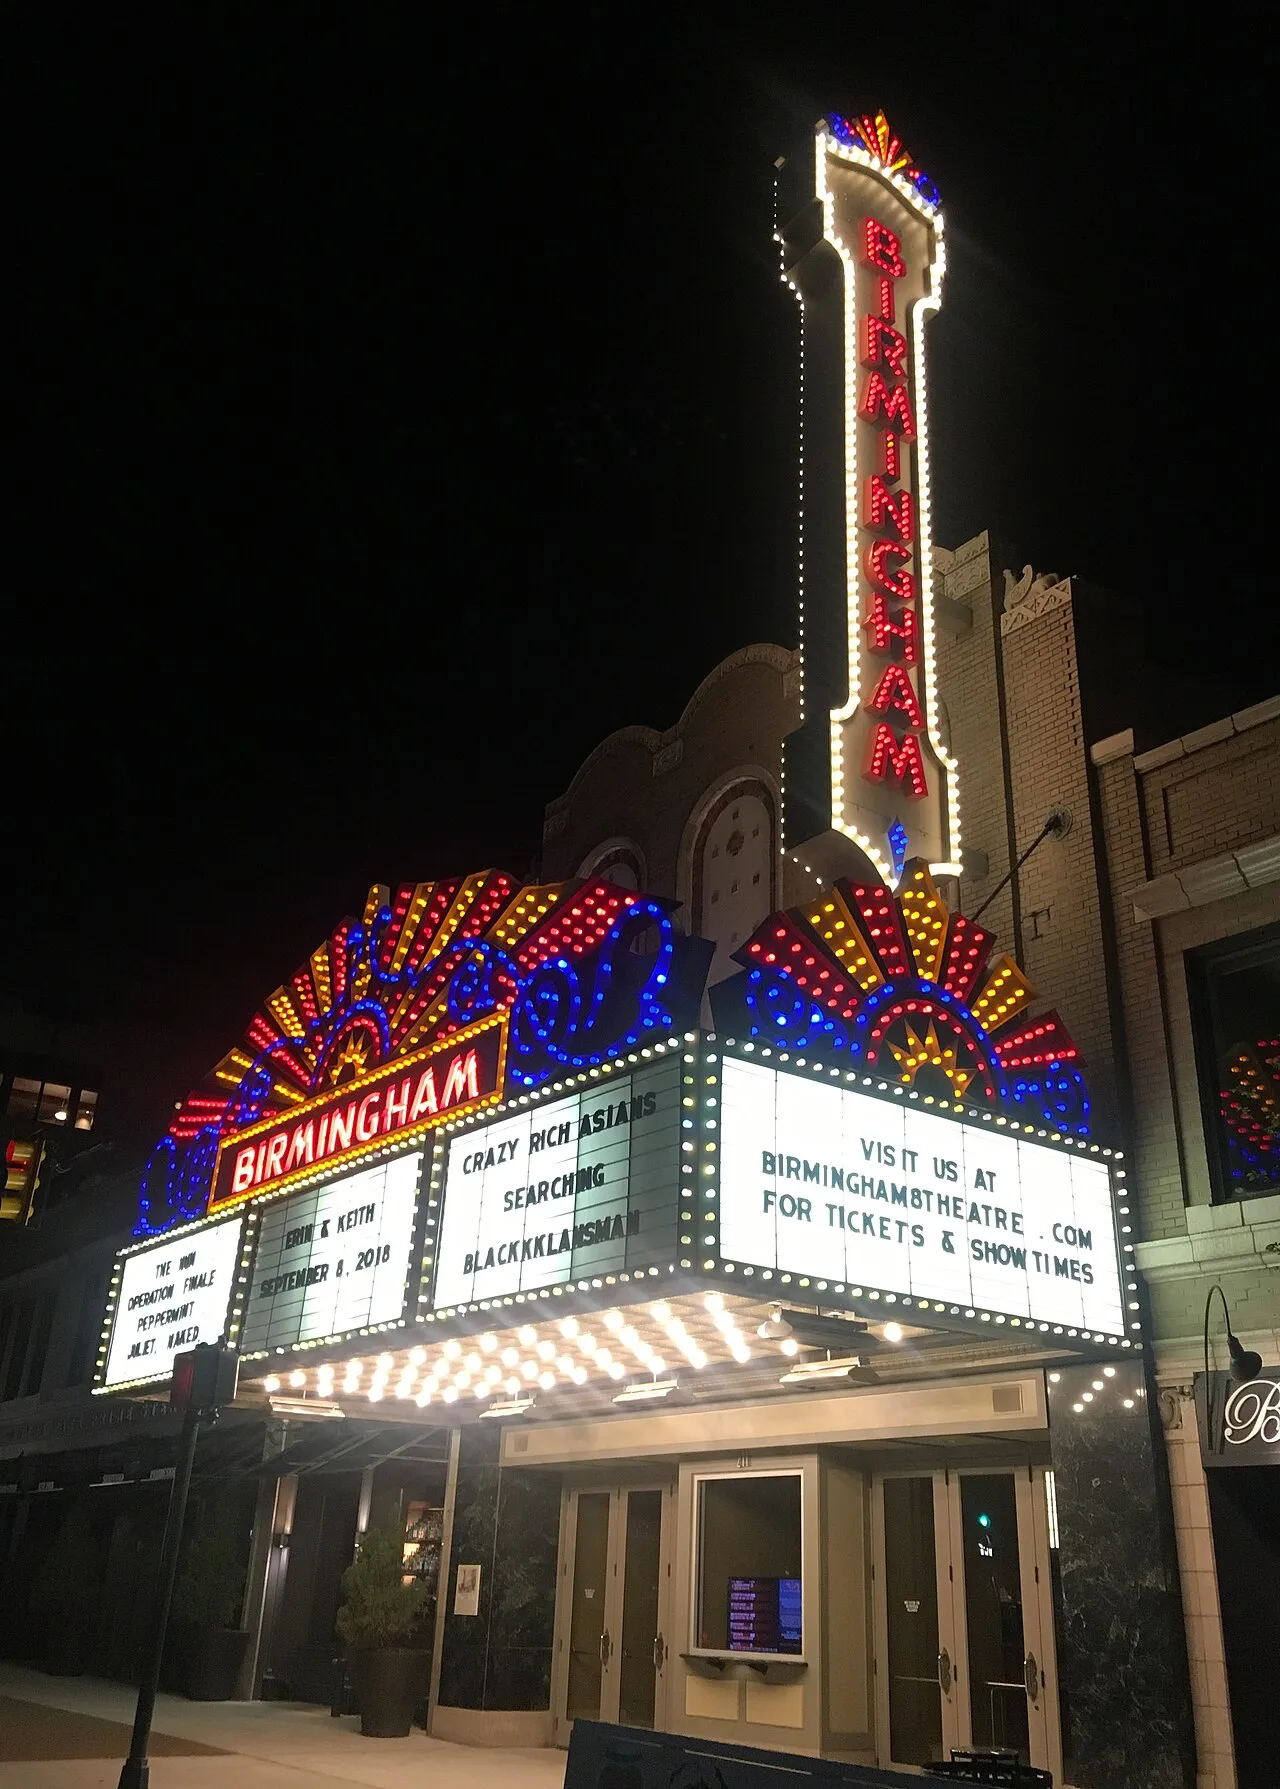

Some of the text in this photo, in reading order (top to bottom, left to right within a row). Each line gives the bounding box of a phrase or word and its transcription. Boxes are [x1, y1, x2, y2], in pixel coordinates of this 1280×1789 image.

[859, 216, 928, 801] BIRMINGHAM
[231, 1047, 479, 1194] BIRMINGHAM
[463, 1091, 657, 1175] CRAZY RICH ASIANS
[503, 1163, 606, 1213] SEARCHING
[860, 1138, 997, 1193] VISIT US AT
[285, 1203, 375, 1249] ERIN & KEITH
[463, 1210, 640, 1275] BLACKKKLANSMAN
[763, 1190, 1095, 1285] FOR TICKETS & SHOWTIMES
[127, 1269, 216, 1312] OPERATION FINALE
[260, 1264, 329, 1298] SEPTEMBER
[355, 1244, 391, 1271] 2018
[136, 1301, 195, 1333] PEPPERMINT
